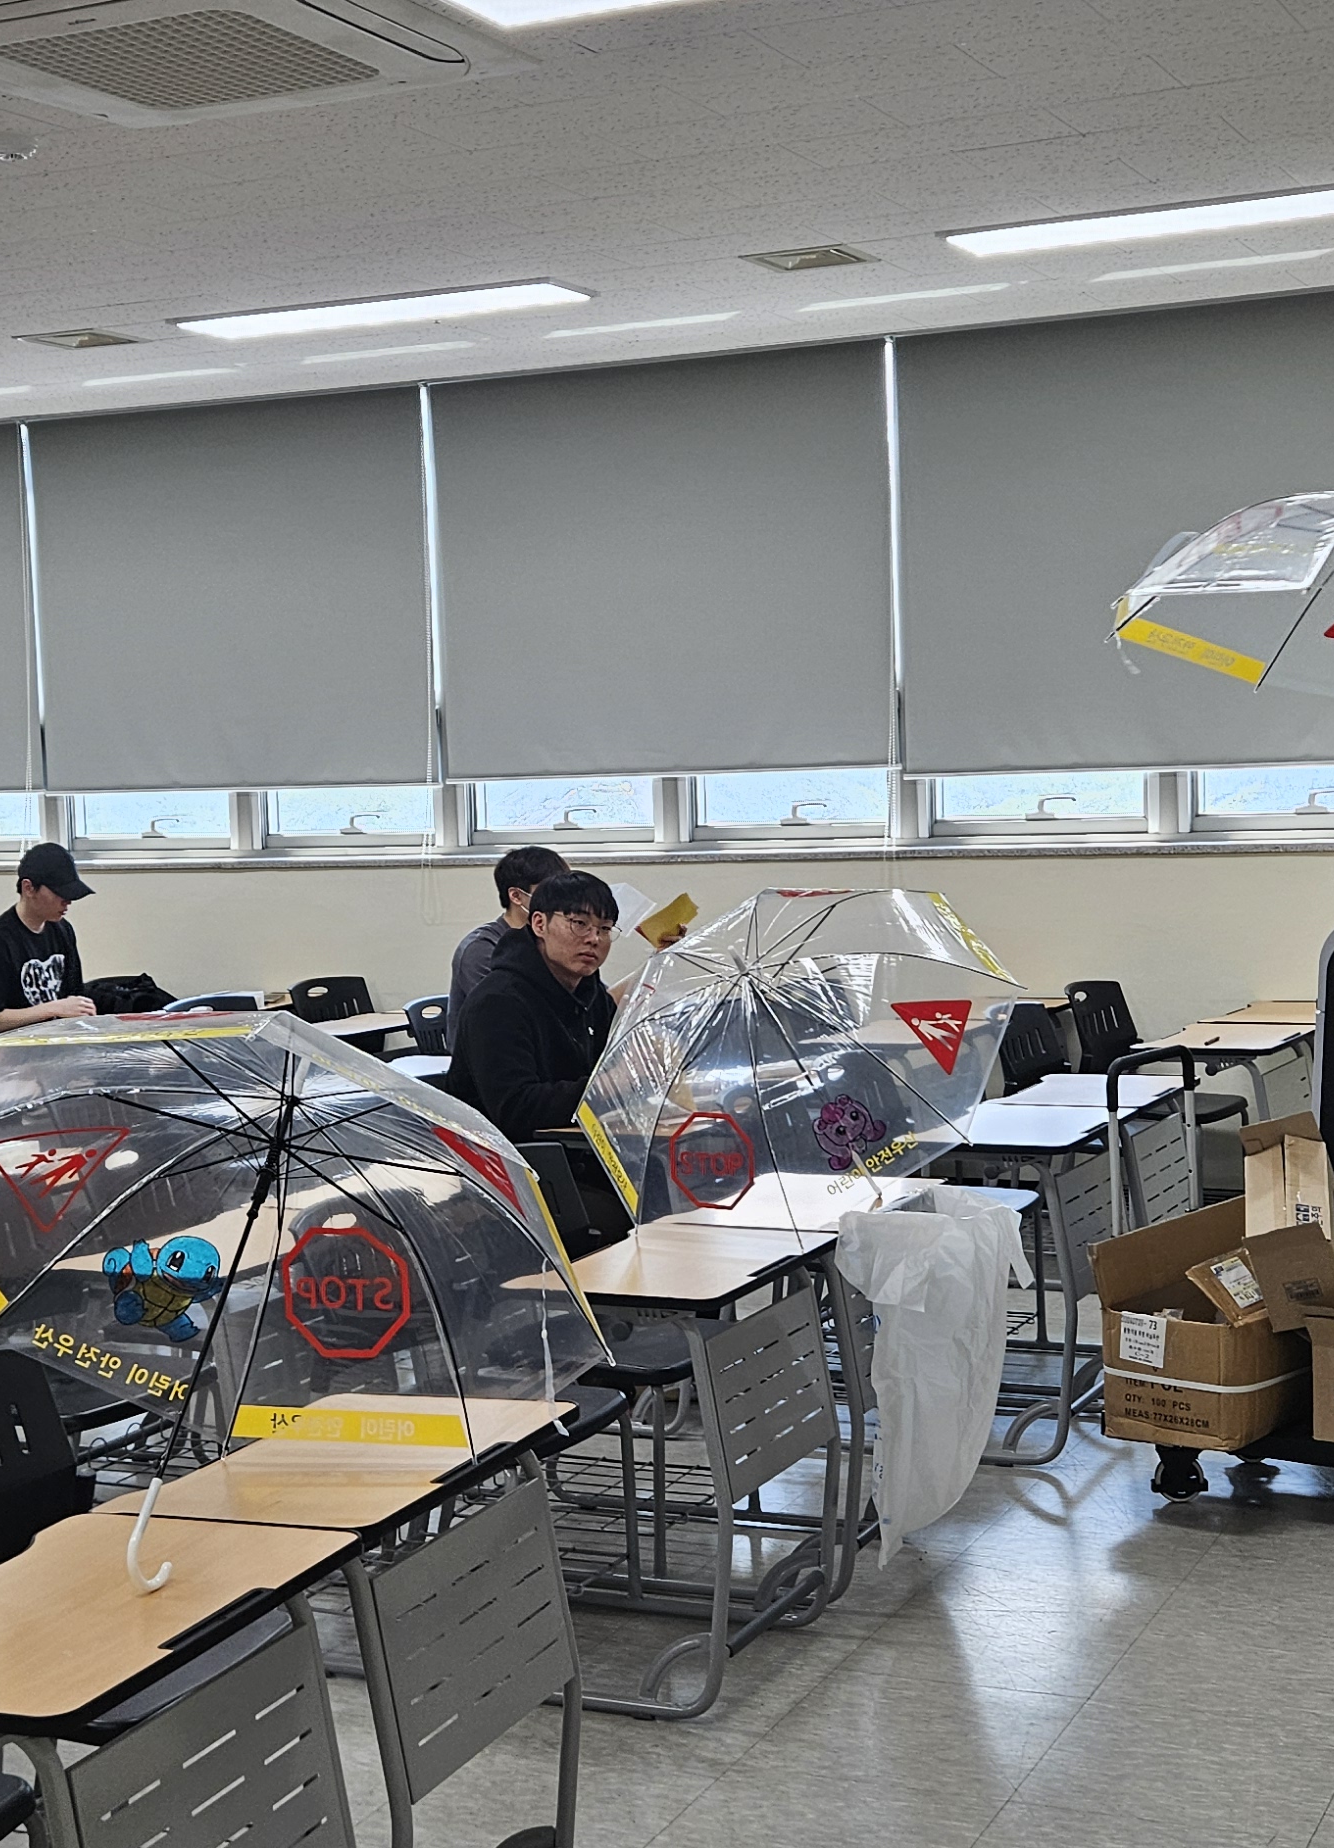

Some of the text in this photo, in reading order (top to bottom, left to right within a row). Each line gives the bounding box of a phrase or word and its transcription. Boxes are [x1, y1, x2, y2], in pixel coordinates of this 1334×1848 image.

[678, 1151, 744, 1176] STOP
[865, 1131, 919, 1173] 안전우산
[1172, 1400, 1191, 1411] PCS
